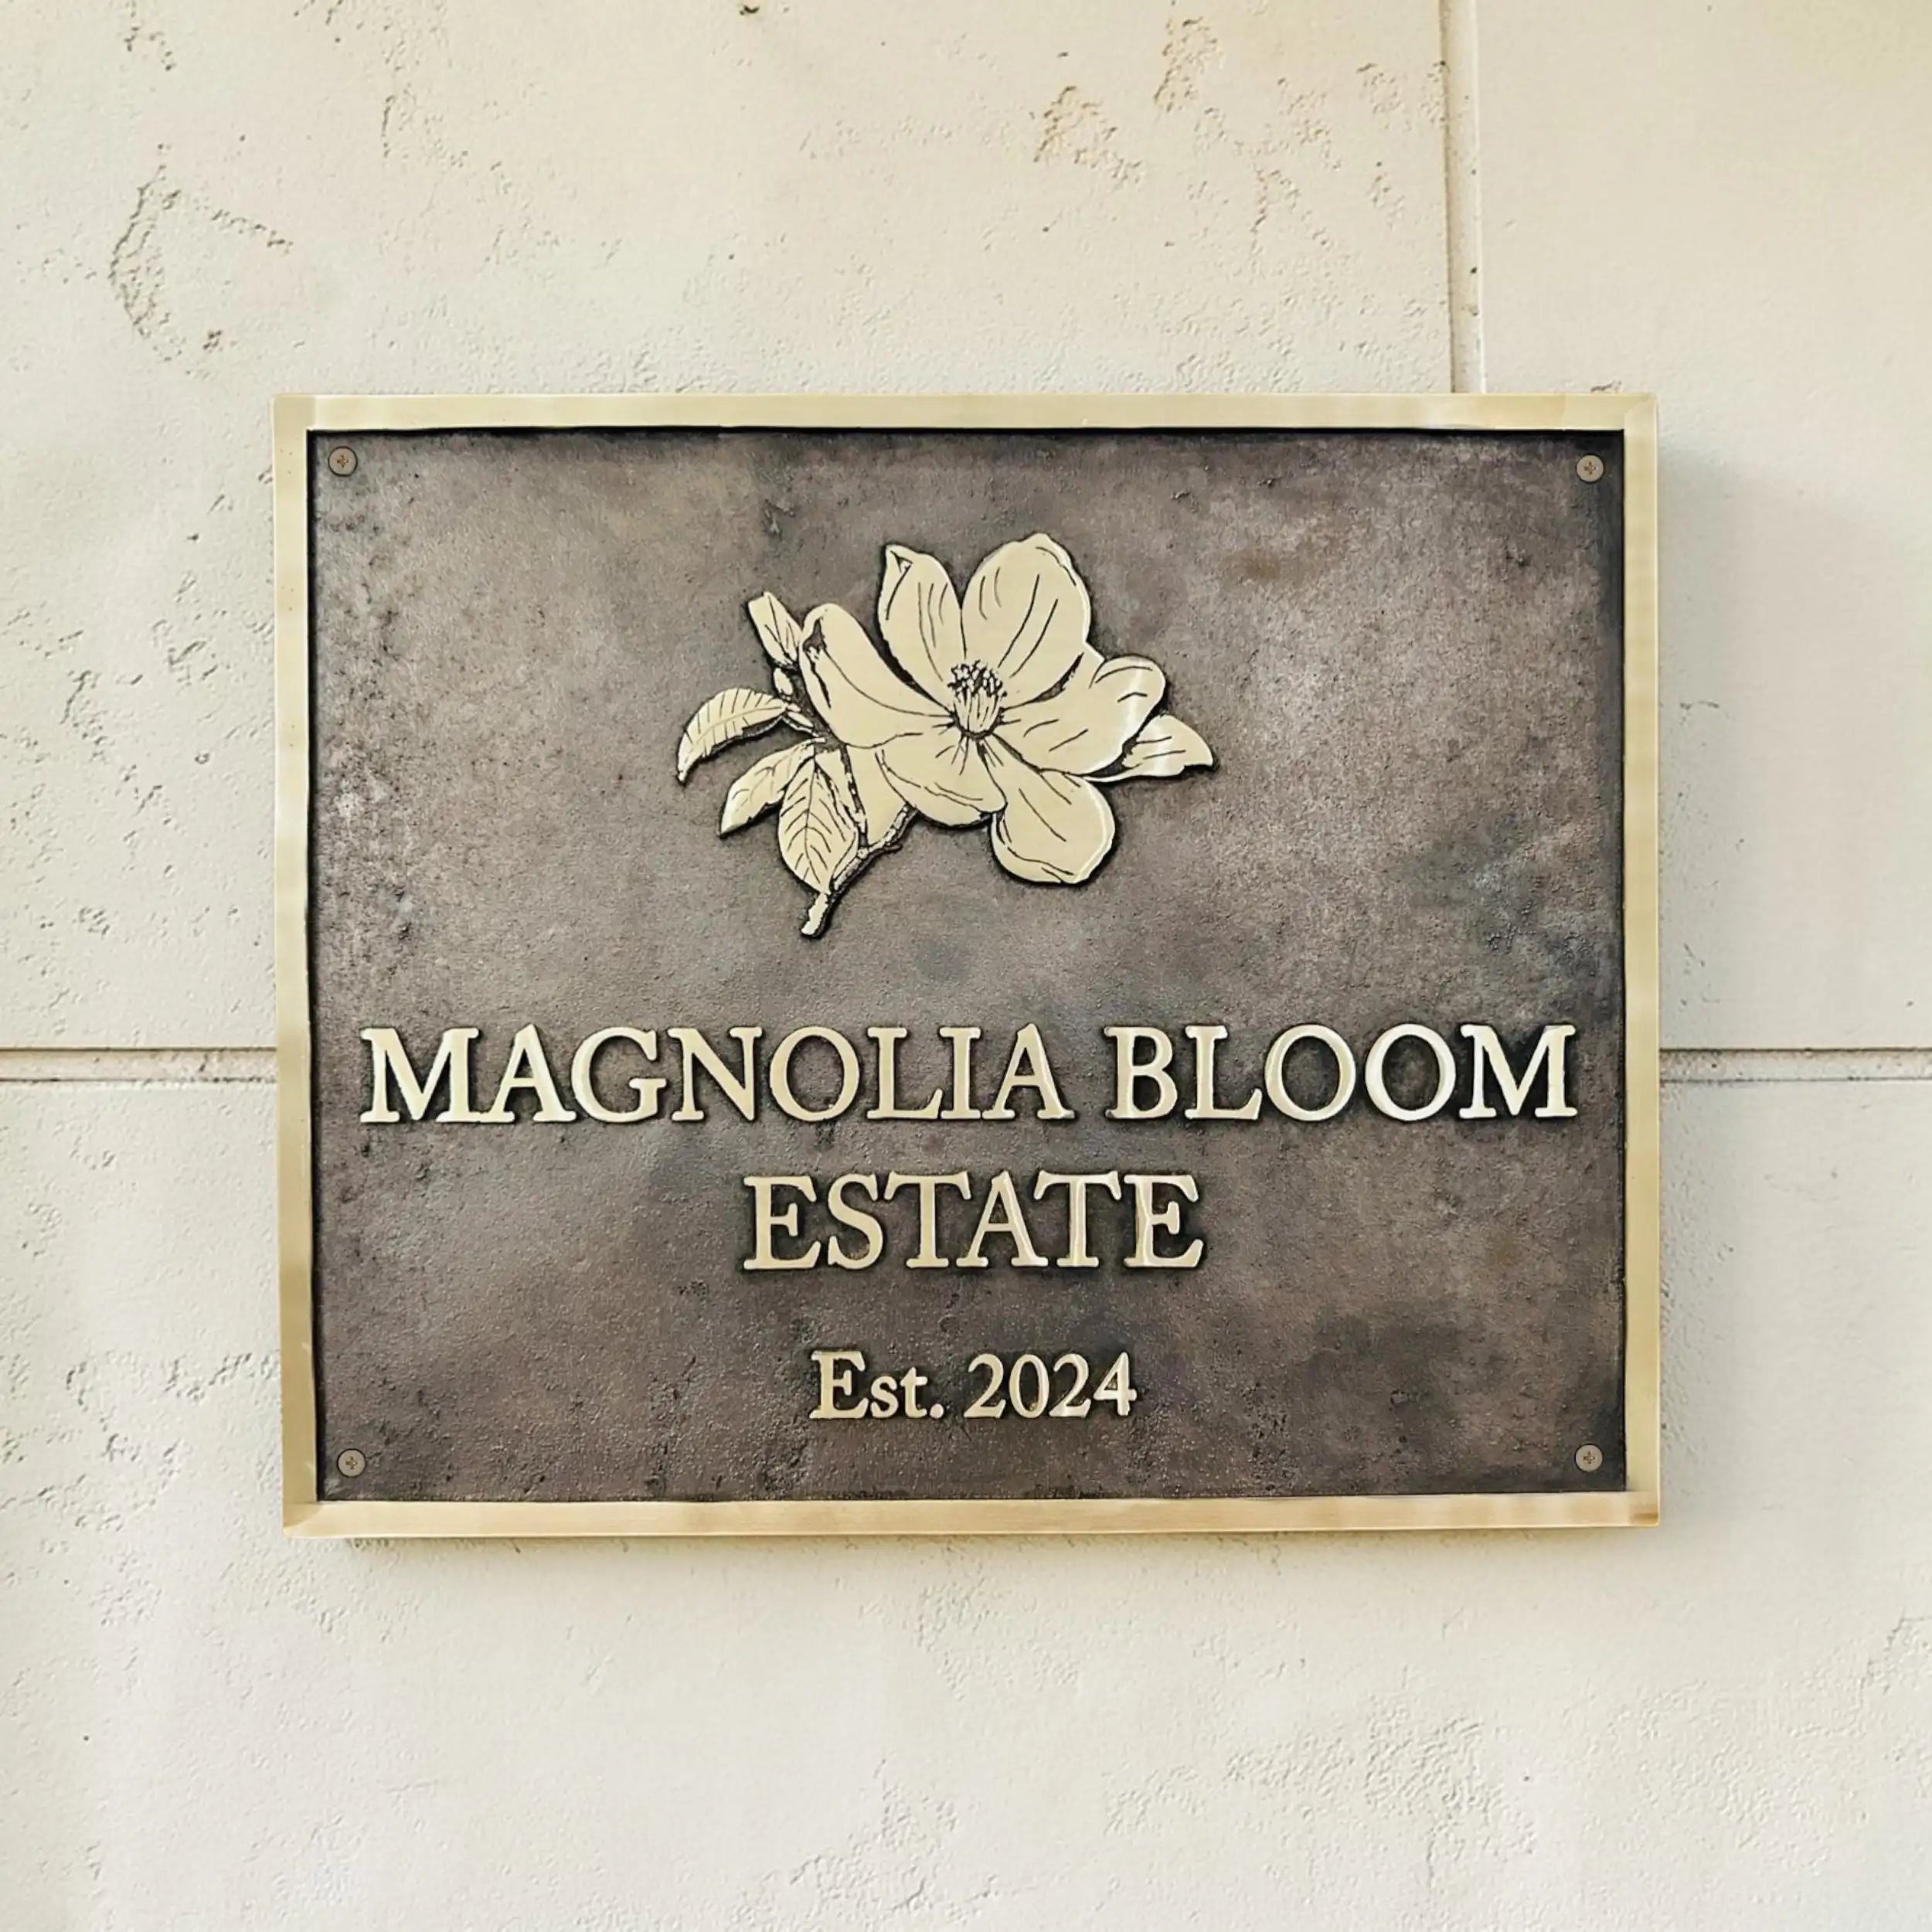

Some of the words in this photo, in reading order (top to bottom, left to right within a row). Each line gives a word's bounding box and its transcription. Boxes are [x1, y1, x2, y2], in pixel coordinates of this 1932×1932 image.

[359, 1024, 1073, 1123] MAGNOLIA
[1104, 1023, 1578, 1121] BLOOM
[743, 1171, 1203, 1270] ESTATE
[809, 1351, 944, 1419] Est.
[964, 1352, 1137, 1418] 2024
